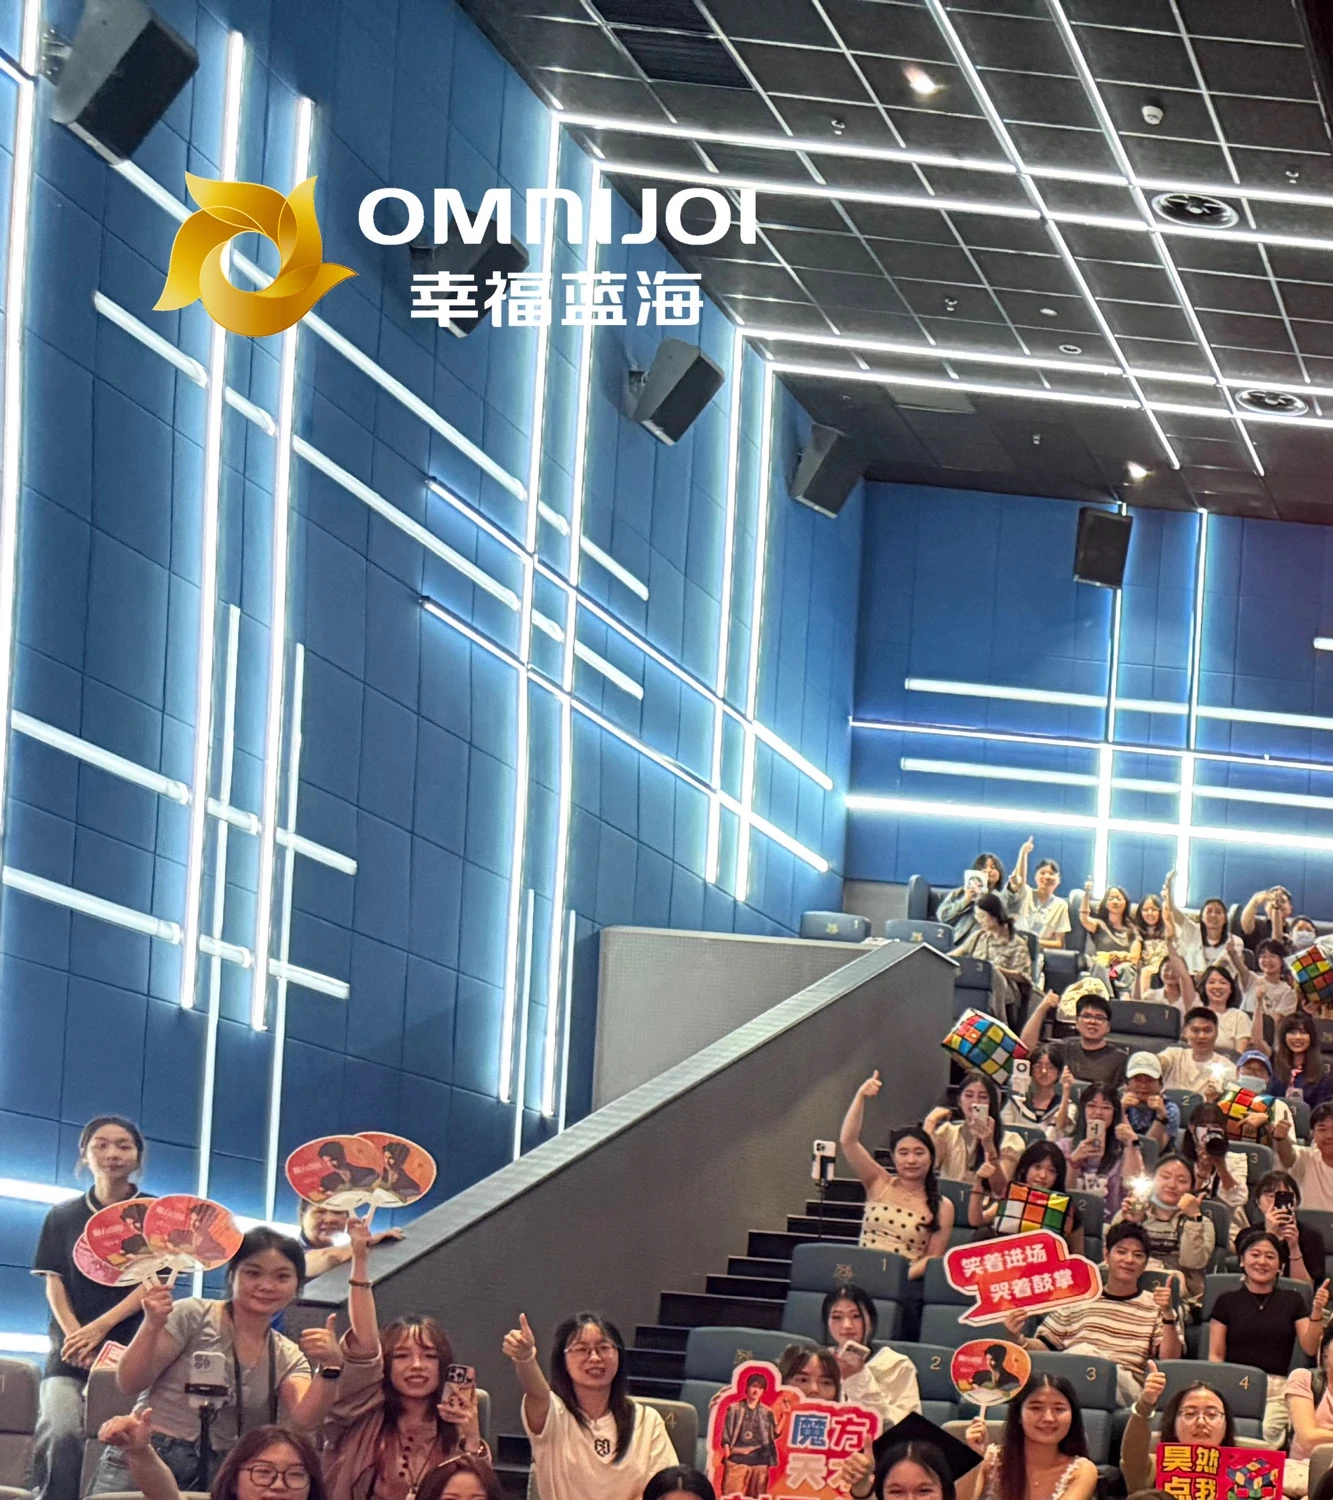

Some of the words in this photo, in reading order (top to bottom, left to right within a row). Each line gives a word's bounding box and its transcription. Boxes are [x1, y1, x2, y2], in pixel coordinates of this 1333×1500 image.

[937, 929, 943, 938] 2
[1183, 1096, 1190, 1106] 2
[1251, 1153, 1258, 1163] 3
[1079, 1200, 1087, 1210] 2
[883, 1259, 886, 1271] 1
[960, 1242, 1047, 1278] 笑着进场
[989, 1265, 1074, 1303] 哭着鼓掌
[931, 1356, 941, 1369] 2
[1087, 1367, 1096, 1380] 3
[1240, 1376, 1249, 1389] 4
[665, 1412, 677, 1428] 4
[788, 1411, 870, 1450] 魔方
[1162, 1445, 1220, 1474] 昊然
